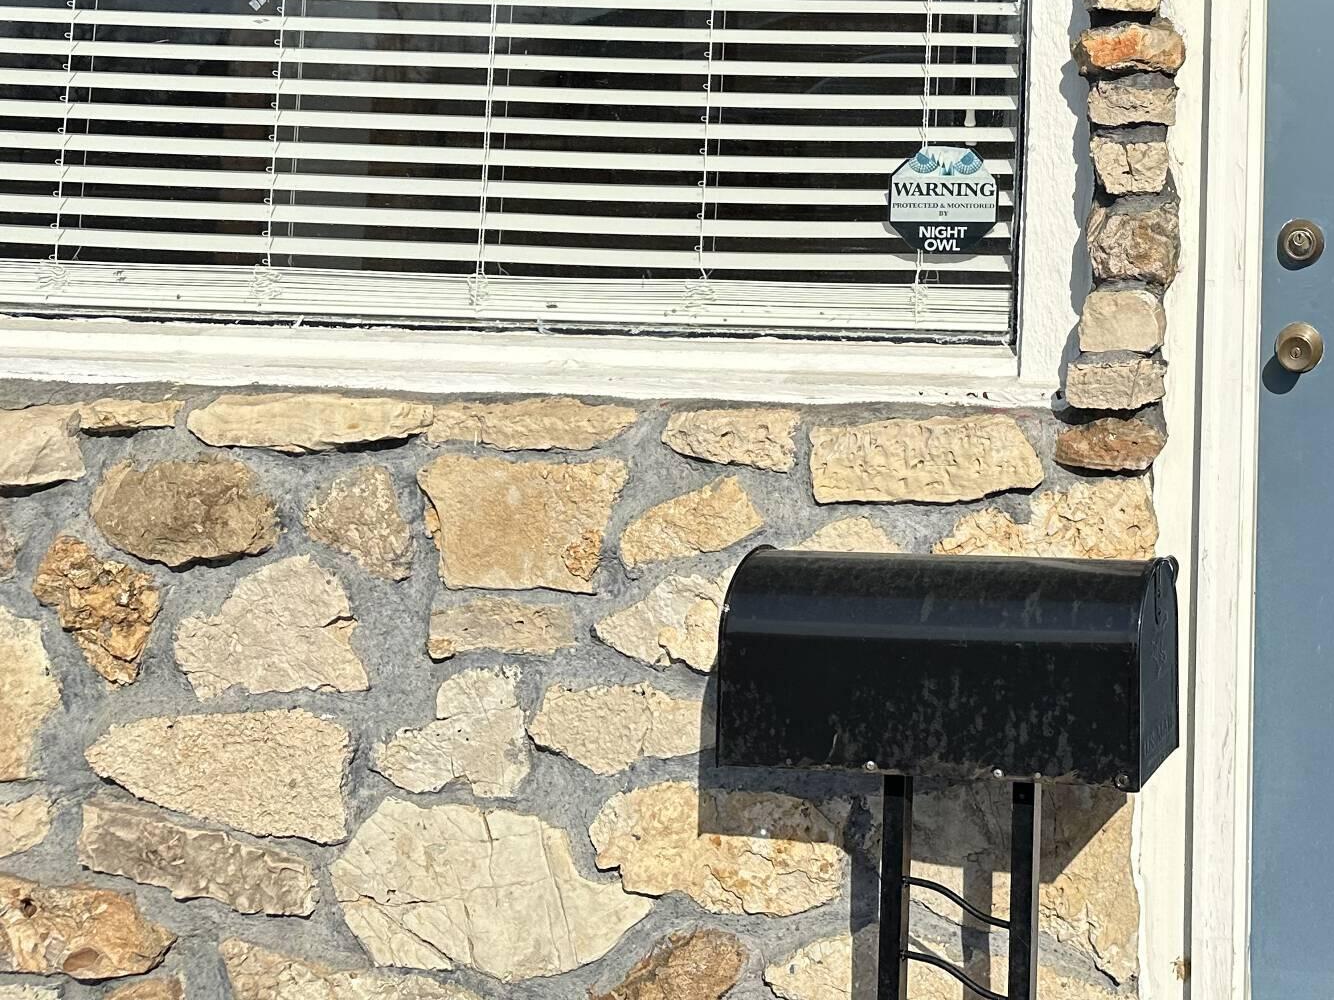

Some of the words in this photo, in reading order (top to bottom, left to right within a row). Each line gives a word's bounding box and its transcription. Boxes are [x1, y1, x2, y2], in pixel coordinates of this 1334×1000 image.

[893, 182, 995, 197] WARNING
[918, 226, 967, 238] NIGHT
[924, 239, 961, 251] OWL
